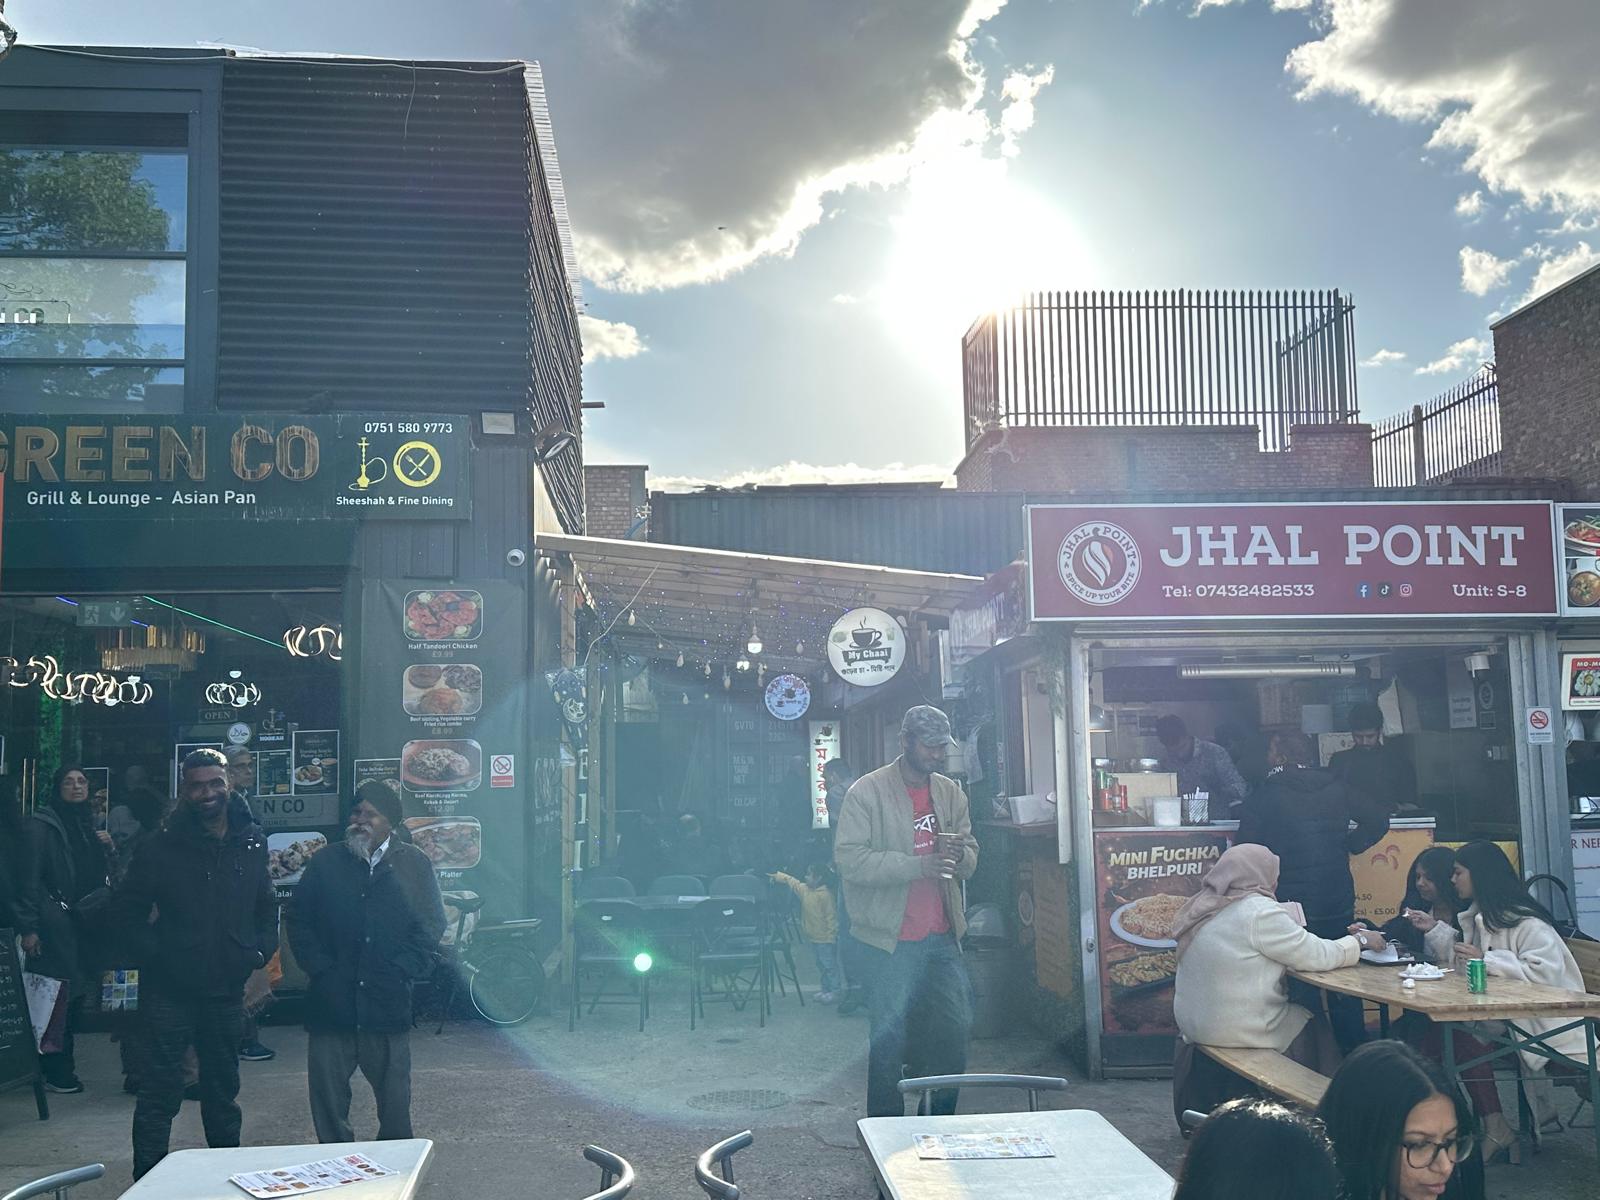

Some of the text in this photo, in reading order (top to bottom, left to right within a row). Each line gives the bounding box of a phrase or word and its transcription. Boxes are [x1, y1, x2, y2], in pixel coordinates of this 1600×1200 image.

[364, 422, 453, 433] 0751 580 9773
[230, 424, 319, 482] CO
[27, 490, 64, 505] Grill
[71, 491, 82, 505] &
[88, 490, 150, 507] Lounge
[172, 490, 219, 505] Asian
[224, 490, 256, 504] Pan
[336, 496, 453, 507] Sheeshah & Fine Dining
[1063, 526, 1137, 560] JHAL POINT
[1159, 523, 1525, 568] JHAL POINT
[1066, 571, 1135, 601] SPICE UP YOUR BITE
[1162, 584, 1315, 598] Tel: 07432482533
[1452, 583, 1527, 598] Unit: S-8
[848, 651, 860, 660] My
[204, 711, 231, 721] OPEN
[282, 799, 305, 814] CO
[1571, 837, 1600, 848] R NEE
[1110, 845, 1220, 867] MINI FUCHKA
[440, 871, 463, 879] Platter
[1127, 862, 1203, 880] BHELPURI
[1375, 907, 1396, 915] £5.00
